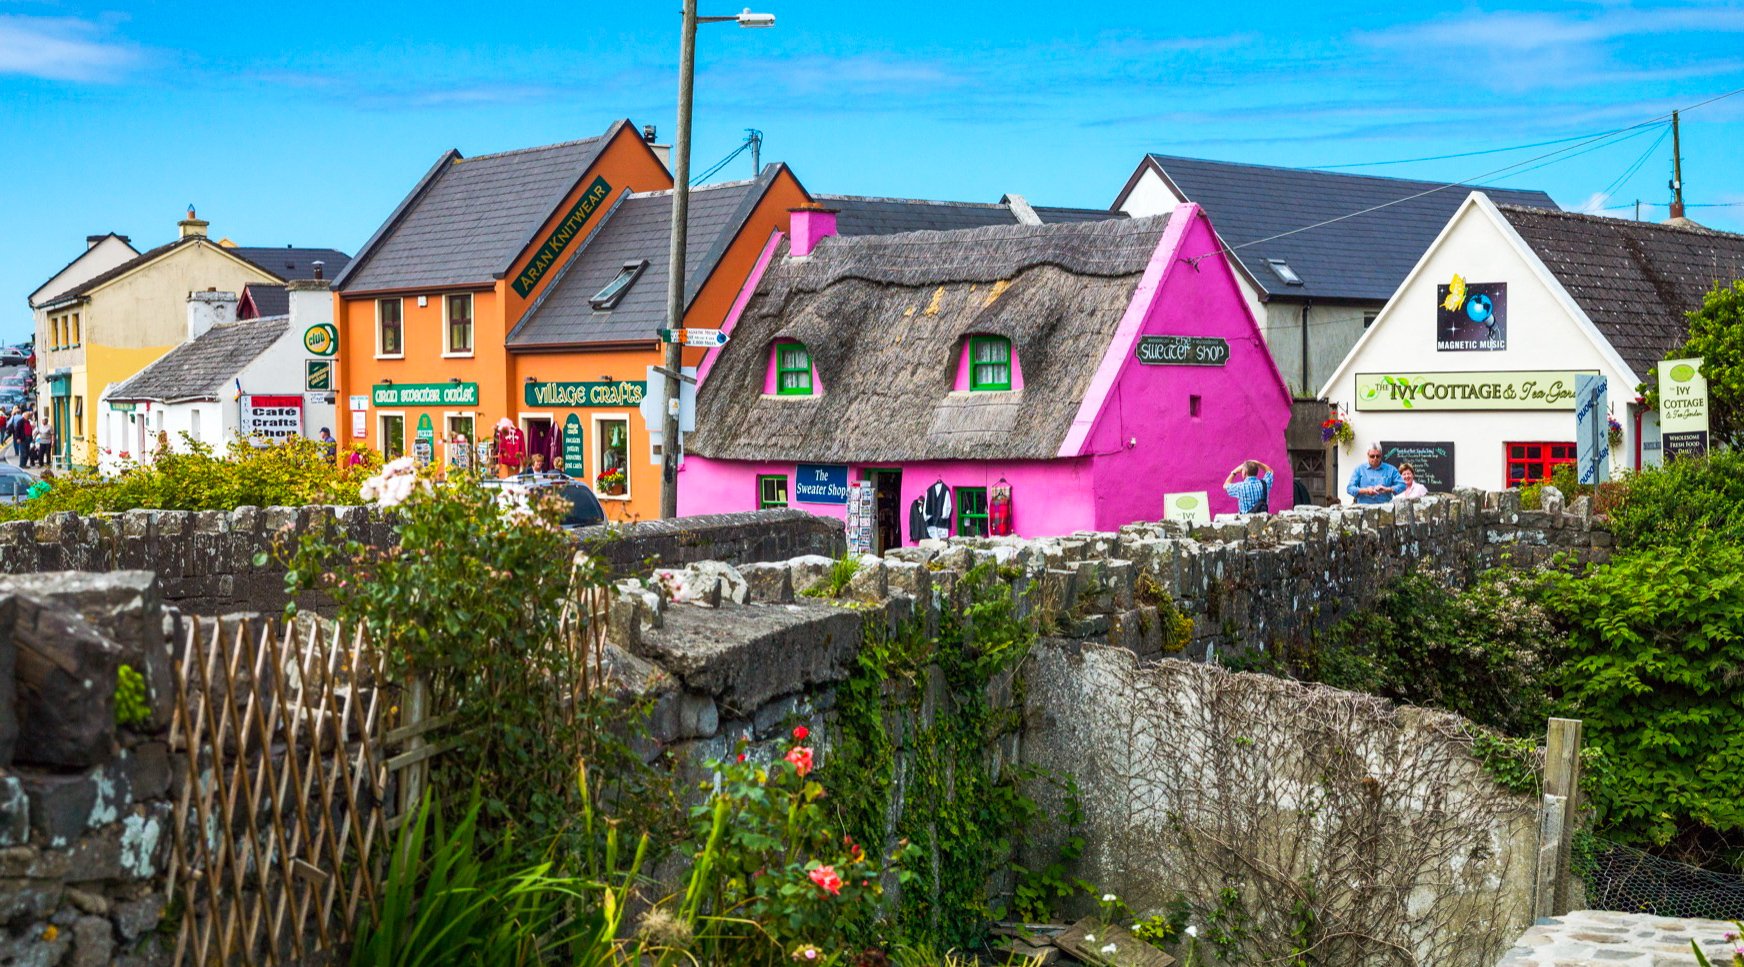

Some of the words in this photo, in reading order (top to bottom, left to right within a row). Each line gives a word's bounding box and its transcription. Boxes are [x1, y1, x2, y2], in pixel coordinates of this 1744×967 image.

[521, 250, 553, 290] ARAN
[549, 185, 606, 252] KNITWEAR
[308, 332, 326, 346] club
[1438, 341, 1477, 350] MAGNETIC
[1480, 340, 1505, 349] MUSIC
[1141, 343, 1192, 360] sweater
[1196, 345, 1224, 361] shop
[400, 387, 441, 403] sweater
[443, 385, 475, 402] outlet
[534, 382, 587, 406] village
[1375, 383, 1389, 391] THE
[1390, 383, 1418, 400] IVY
[1421, 382, 1502, 400] COTTAGE
[1503, 383, 1517, 399] &
[1519, 381, 1545, 399] Tea
[1545, 381, 1576, 403] Gar
[1676, 386, 1691, 396] IVY
[1663, 398, 1704, 409] COTTAGE
[252, 418, 298, 427] Crafts
[815, 469, 829, 481] The
[796, 483, 827, 495] Sweater
[828, 483, 846, 499] Shop
[1182, 512, 1196, 520] IVY
